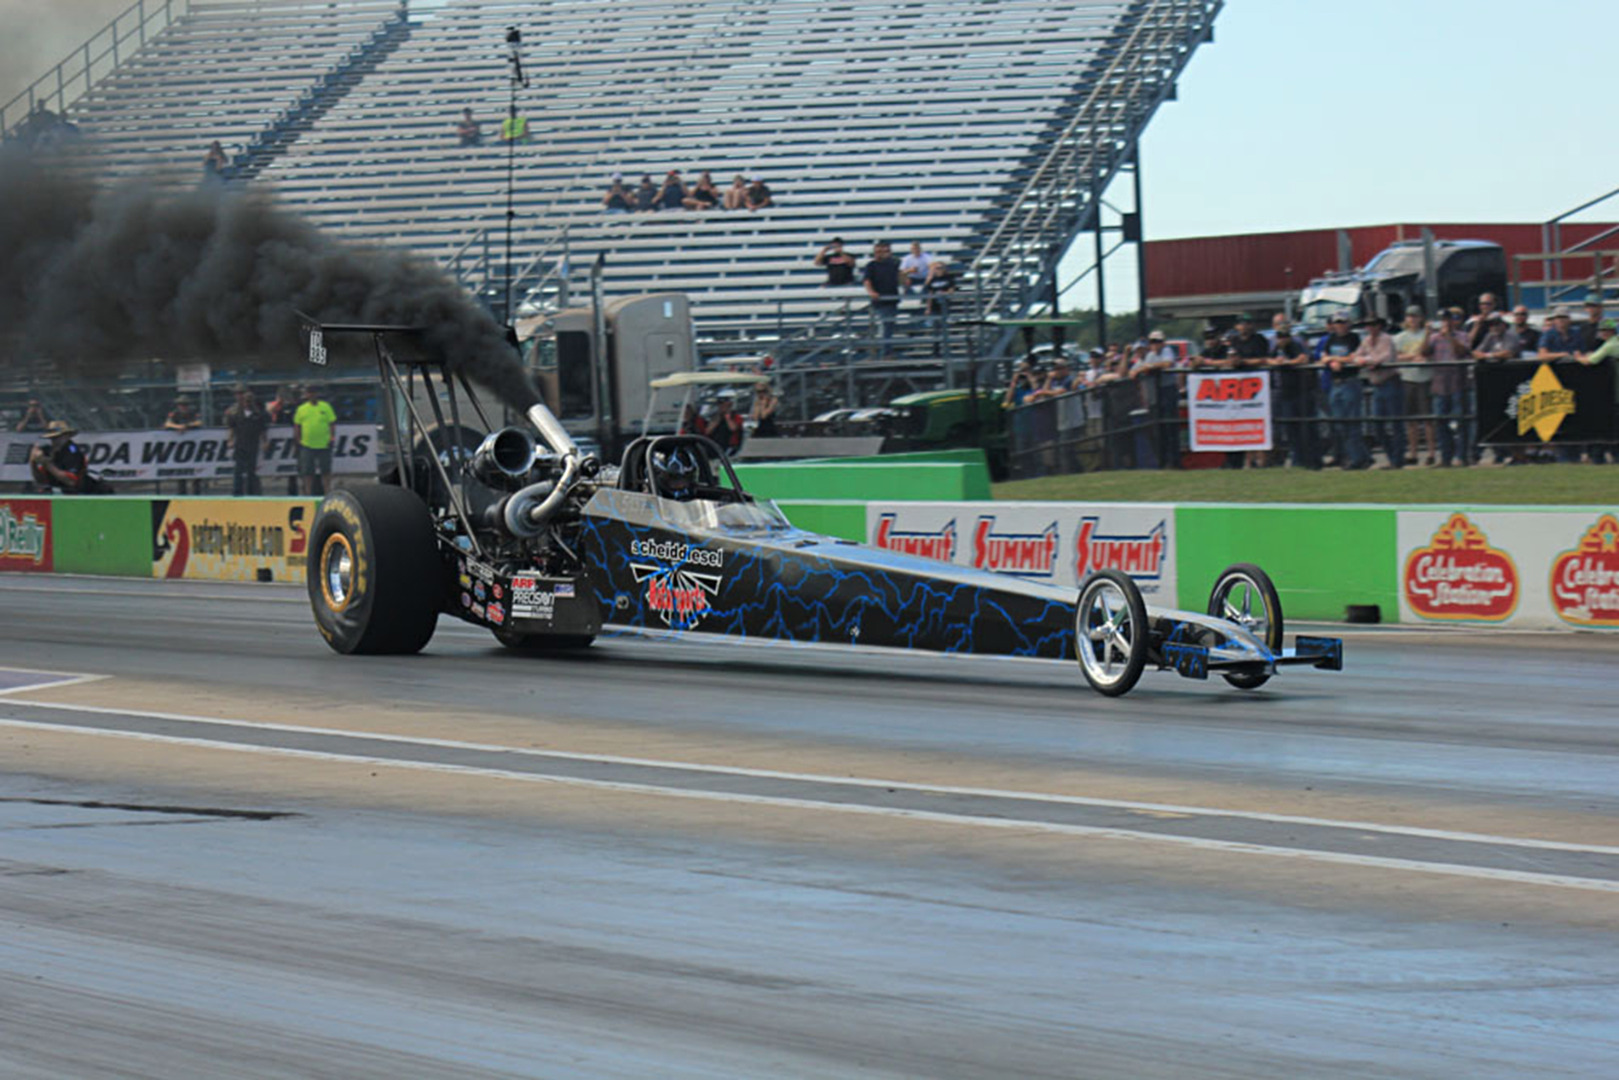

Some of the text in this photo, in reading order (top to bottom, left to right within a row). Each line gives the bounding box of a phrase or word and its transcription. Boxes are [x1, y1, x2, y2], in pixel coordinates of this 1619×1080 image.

[1196, 377, 1263, 401] ARP
[141, 440, 233, 464] WORL
[264, 434, 371, 459] FILS
[1416, 555, 1504, 583] Celebration
